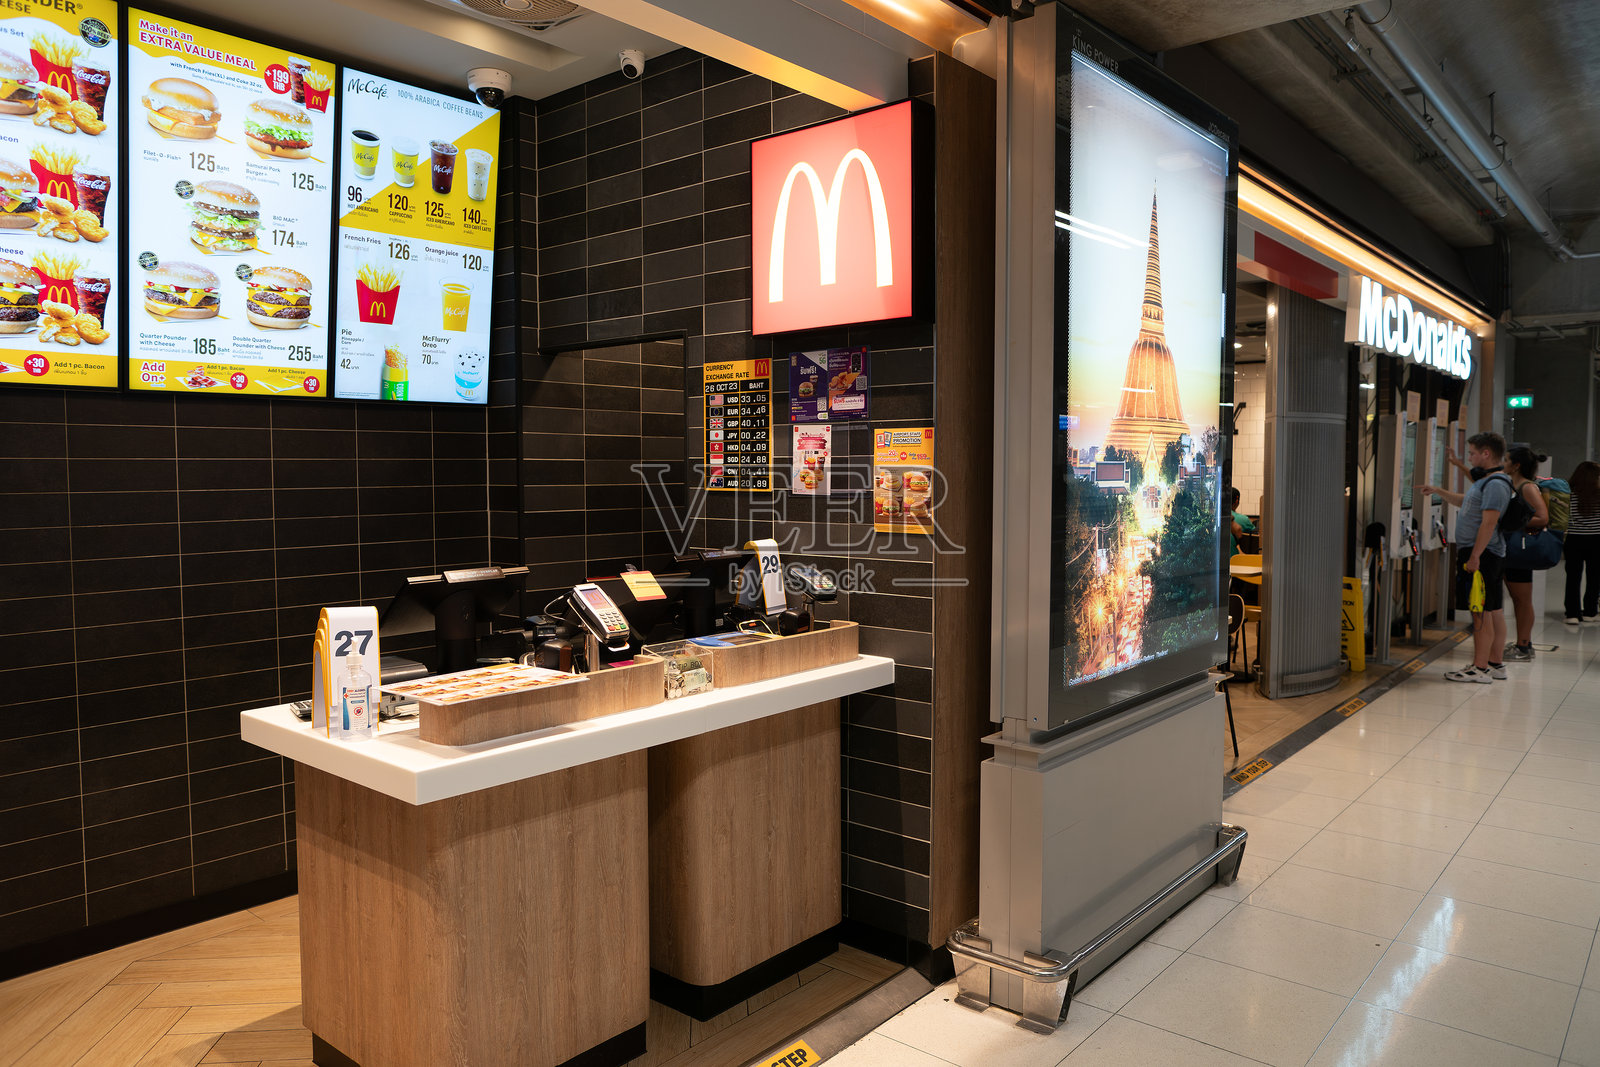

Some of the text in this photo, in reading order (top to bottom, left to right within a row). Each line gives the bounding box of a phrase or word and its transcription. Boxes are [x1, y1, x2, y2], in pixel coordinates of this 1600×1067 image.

[140, 20, 193, 42] Make it an
[140, 32, 256, 70] EXTRA VALUE MEAL
[1072, 34, 1119, 74] KING POWER
[183, 64, 202, 74] French
[236, 77, 248, 85] Coke
[348, 78, 387, 100] McCafé
[398, 89, 484, 119] 100% ARABICA COFFEE BEANS
[190, 152, 230, 172] 125 Baht
[292, 172, 314, 192] 125
[348, 186, 362, 203] 96
[388, 193, 408, 211] 120
[424, 200, 444, 218] 125
[462, 208, 481, 224] 140
[272, 230, 294, 248] 174
[344, 234, 365, 244] French
[366, 236, 382, 245] Fries
[388, 242, 410, 261] 126
[424, 246, 459, 257] Orange juice
[462, 254, 482, 271] 120
[1358, 275, 1472, 380] McDonald's
[193, 338, 216, 356] 185
[422, 335, 450, 345] McFlurry
[288, 345, 312, 362] 255
[422, 354, 432, 365] 70
[142, 362, 165, 372] Add
[340, 359, 351, 370] 42
[762, 555, 779, 574] 29
[335, 630, 373, 657] 27
